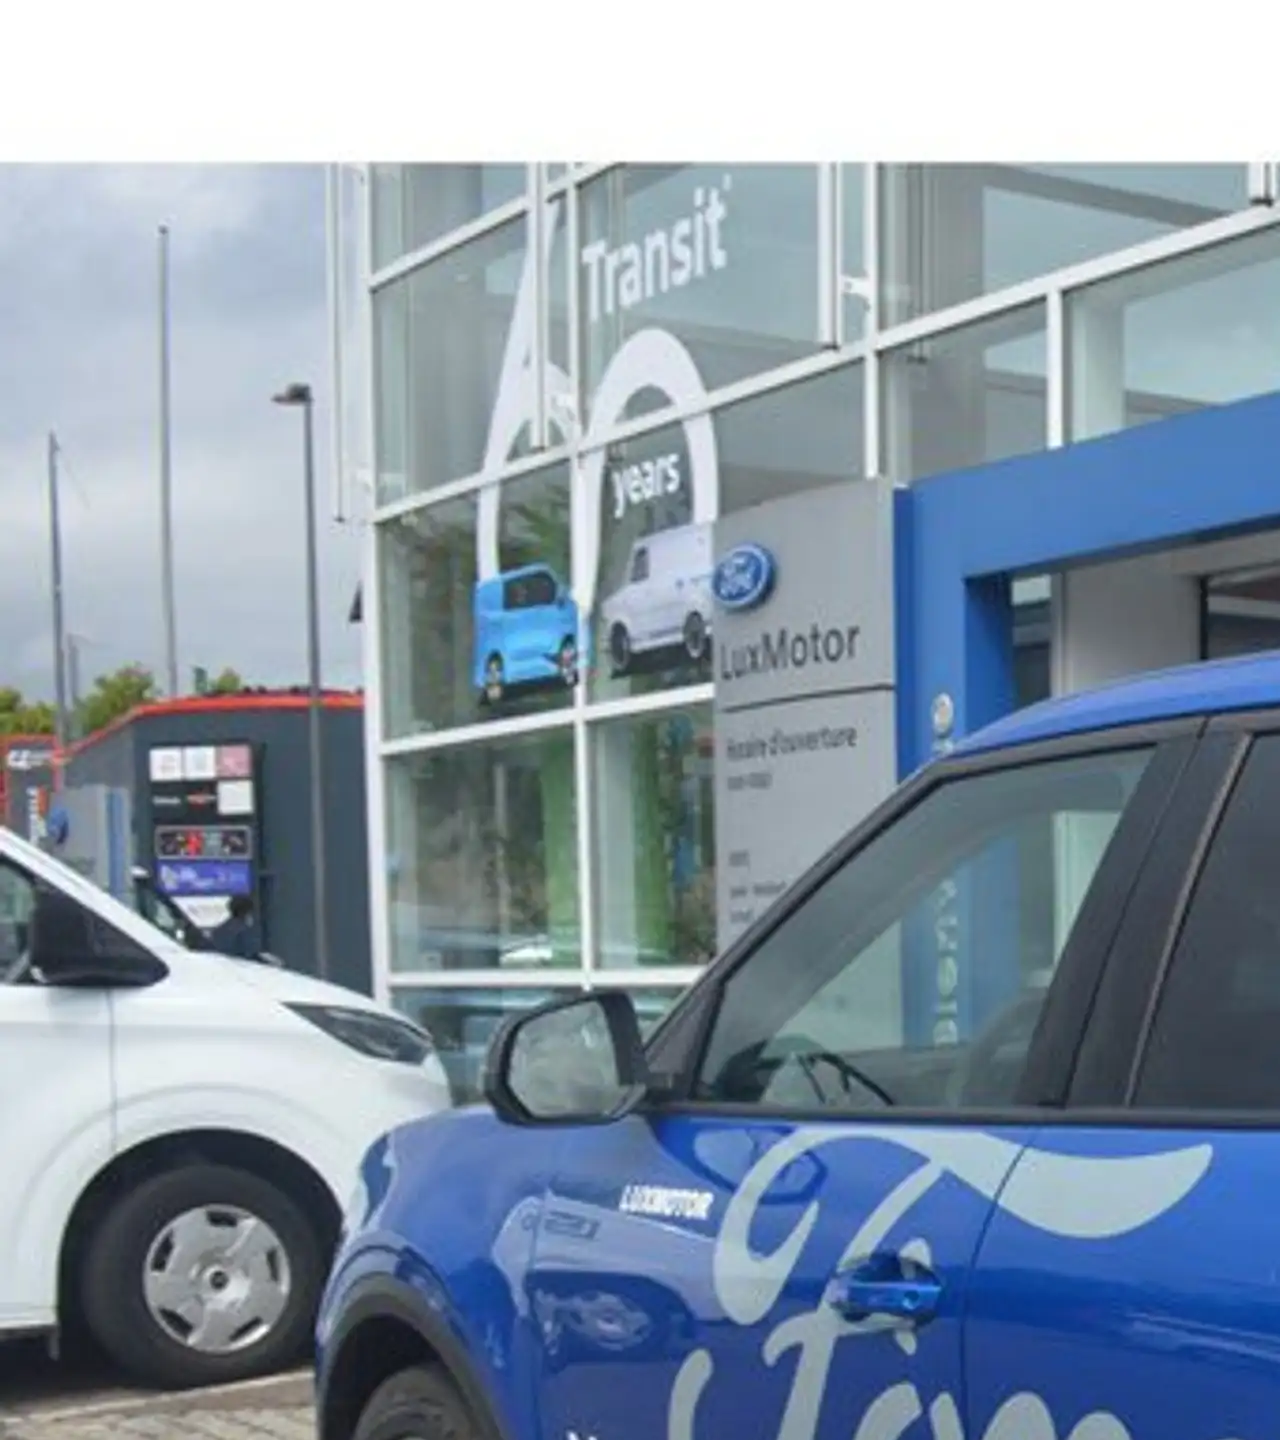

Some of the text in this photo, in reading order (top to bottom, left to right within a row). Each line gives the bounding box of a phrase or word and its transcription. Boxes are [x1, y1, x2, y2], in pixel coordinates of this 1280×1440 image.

[582, 184, 728, 323] Transit
[611, 453, 680, 519] years
[719, 622, 861, 681] LuxMotor
